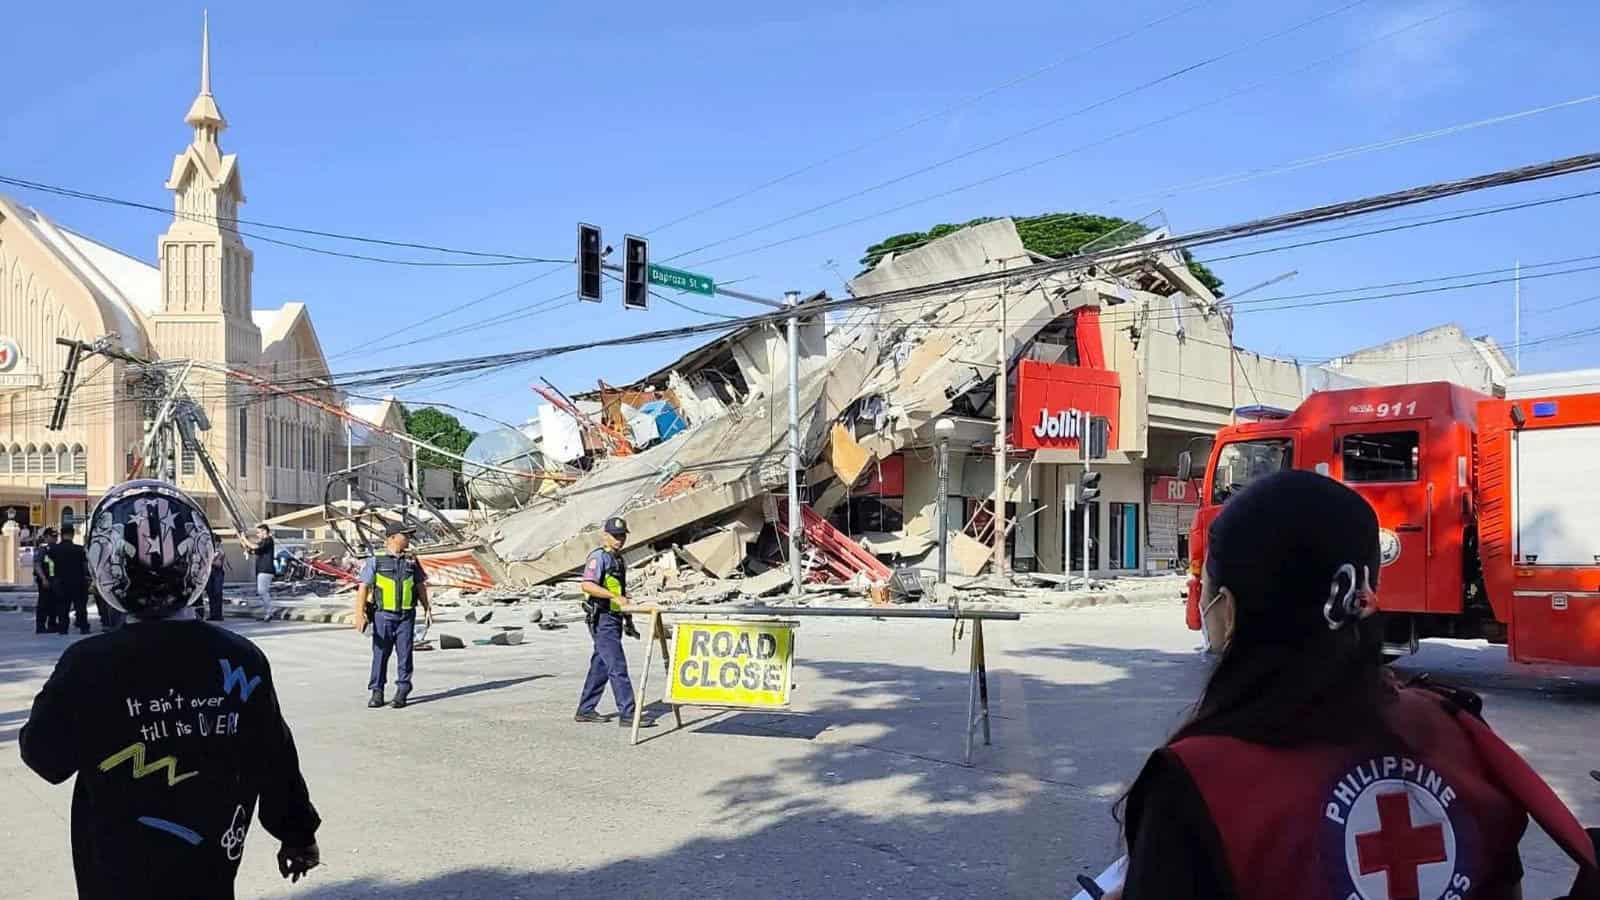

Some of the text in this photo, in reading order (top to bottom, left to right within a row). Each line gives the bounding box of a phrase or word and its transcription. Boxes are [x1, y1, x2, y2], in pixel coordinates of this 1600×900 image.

[1033, 408, 1082, 438] Jolli
[1376, 401, 1417, 417] 911
[690, 630, 777, 660] ROAD
[680, 660, 782, 691] CLOSE
[126, 688, 224, 717] It ain't over
[140, 720, 168, 741] till
[1325, 756, 1457, 825] PHILIPPINE
